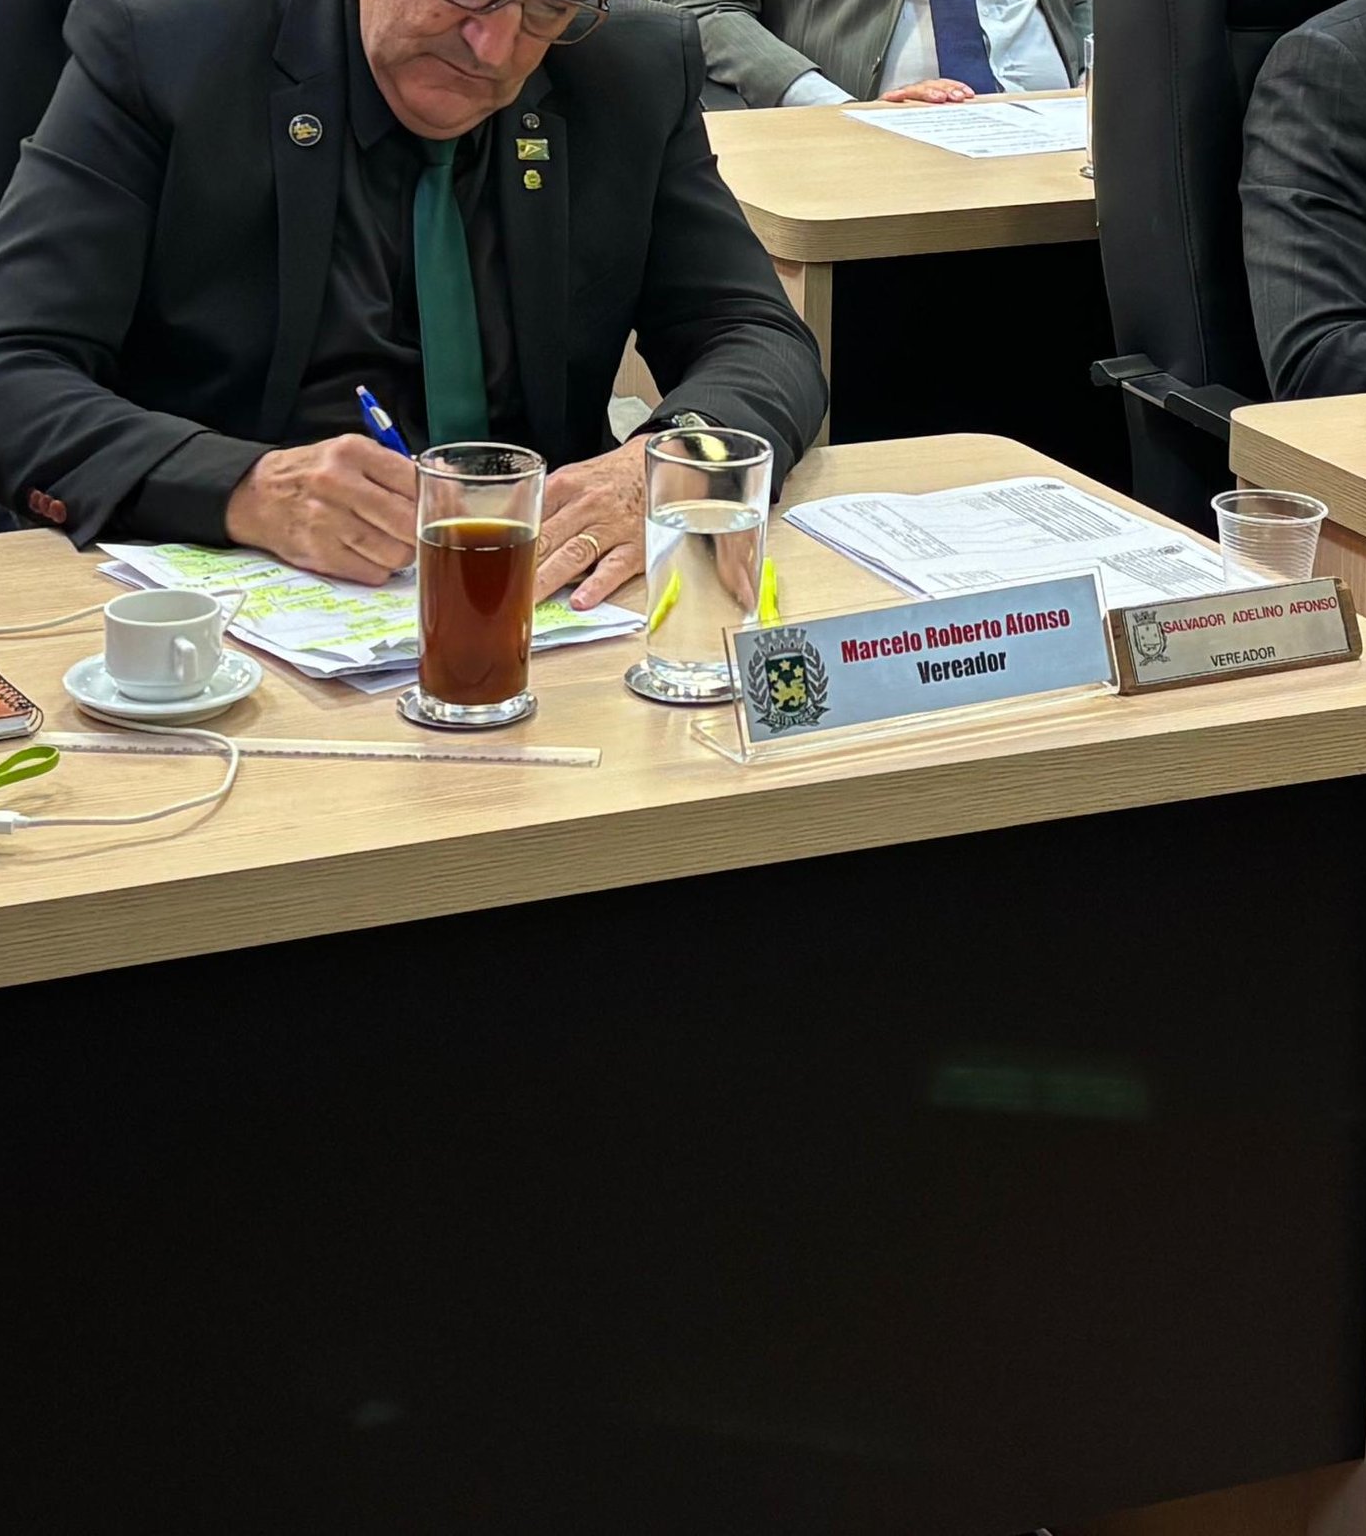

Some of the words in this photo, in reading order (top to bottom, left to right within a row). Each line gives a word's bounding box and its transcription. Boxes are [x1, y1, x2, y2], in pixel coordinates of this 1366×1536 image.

[1163, 614, 1226, 634] SALVADOR
[1233, 605, 1283, 624] ADELINO
[1289, 596, 1338, 614] AFONSO
[841, 630, 922, 663] Marcelo
[926, 619, 1002, 649] Roberto
[1006, 607, 1071, 636] Afonso
[916, 649, 1007, 685] Vereador
[1210, 646, 1276, 667] VEREADOR
